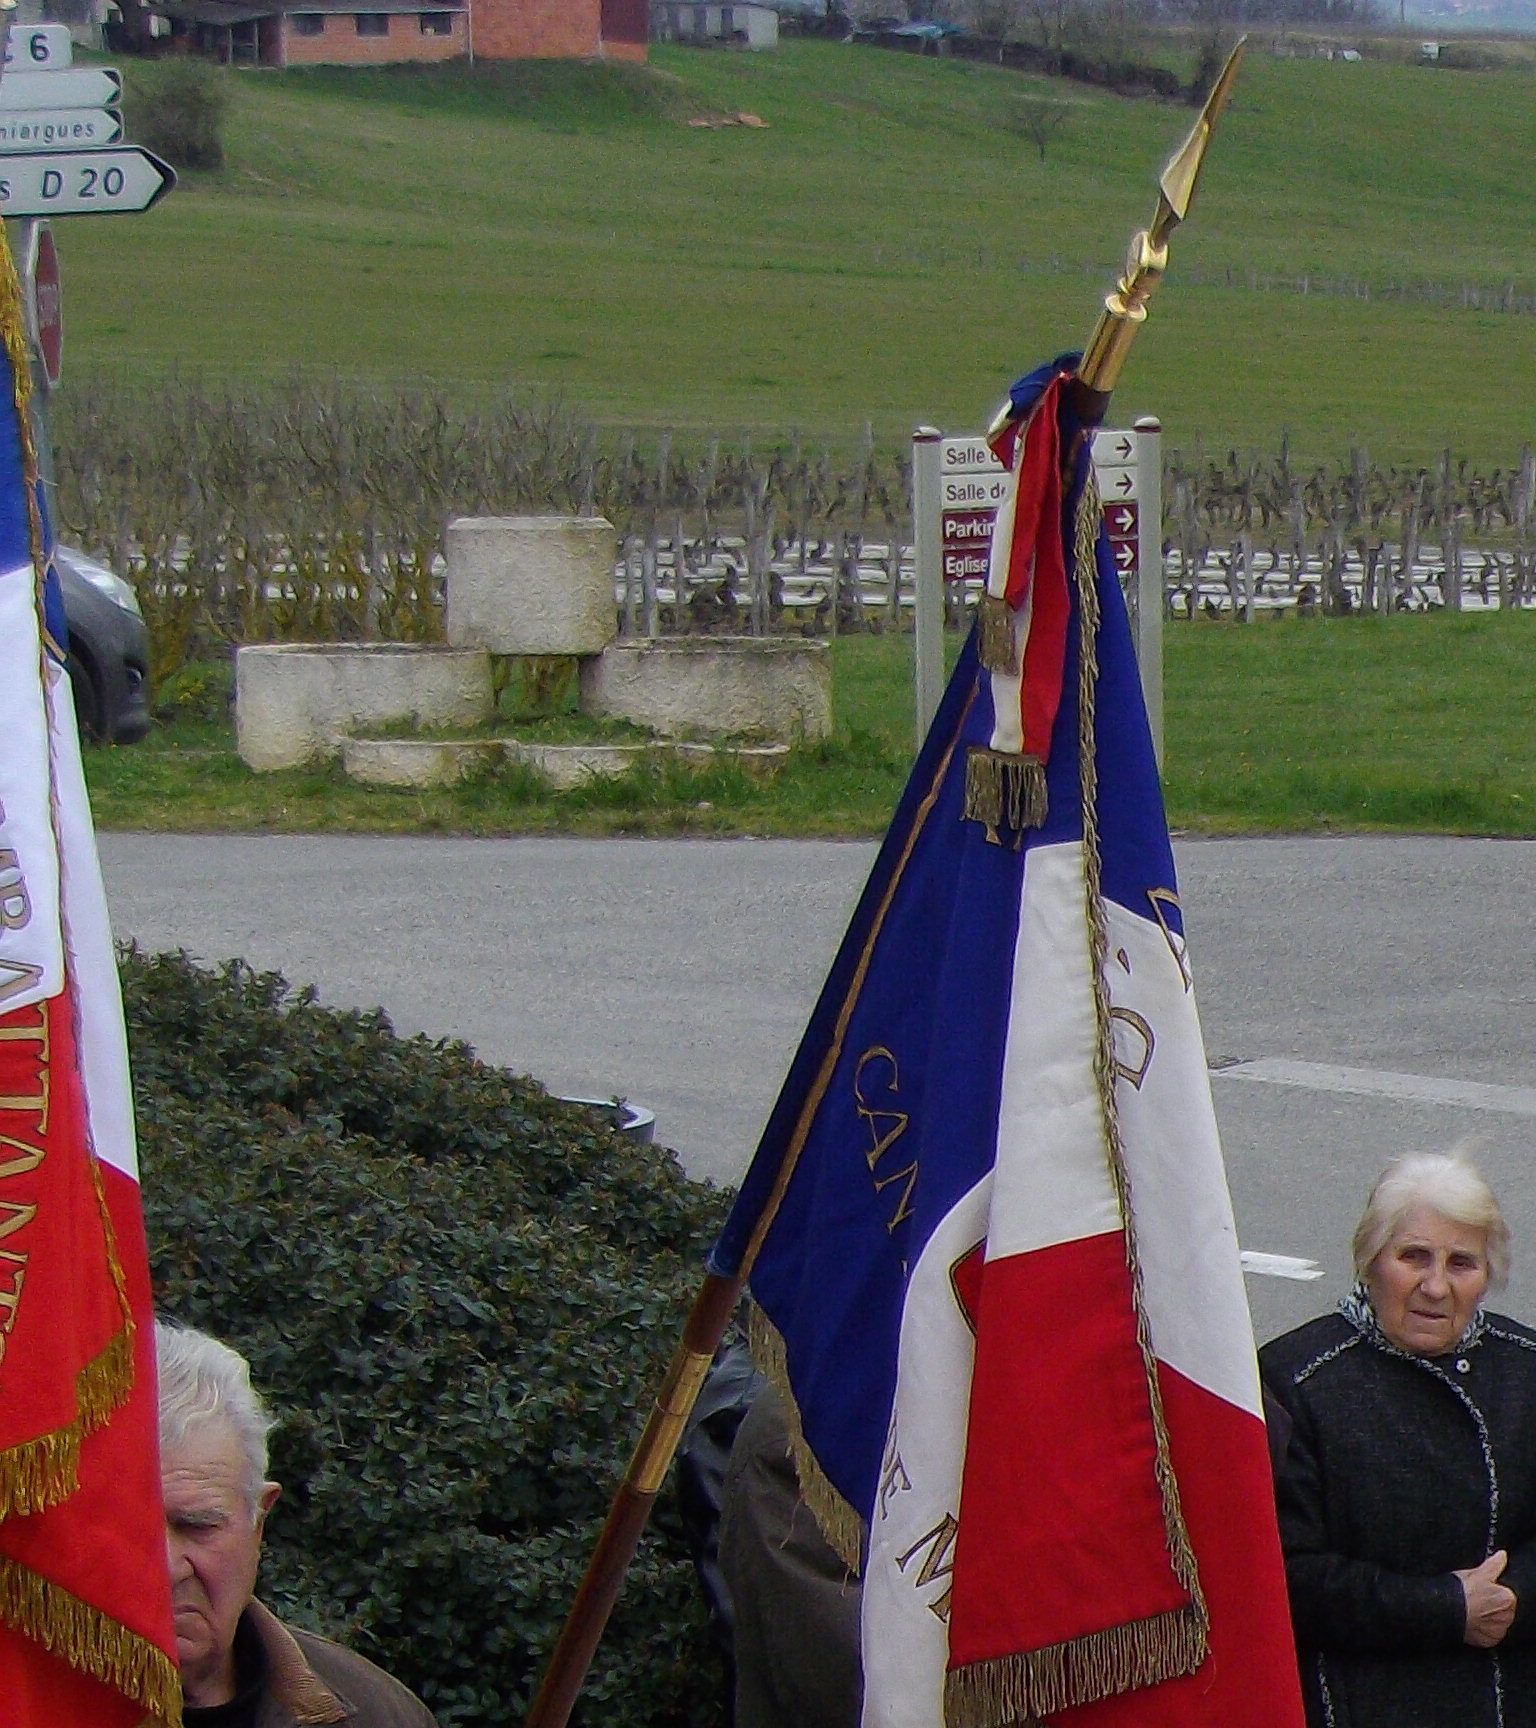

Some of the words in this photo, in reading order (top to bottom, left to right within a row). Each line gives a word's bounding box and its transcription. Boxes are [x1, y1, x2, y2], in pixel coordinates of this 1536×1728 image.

[42, 170, 63, 199] D
[79, 166, 125, 197] 20
[946, 447, 986, 465] Salle
[946, 483, 986, 501] Salle
